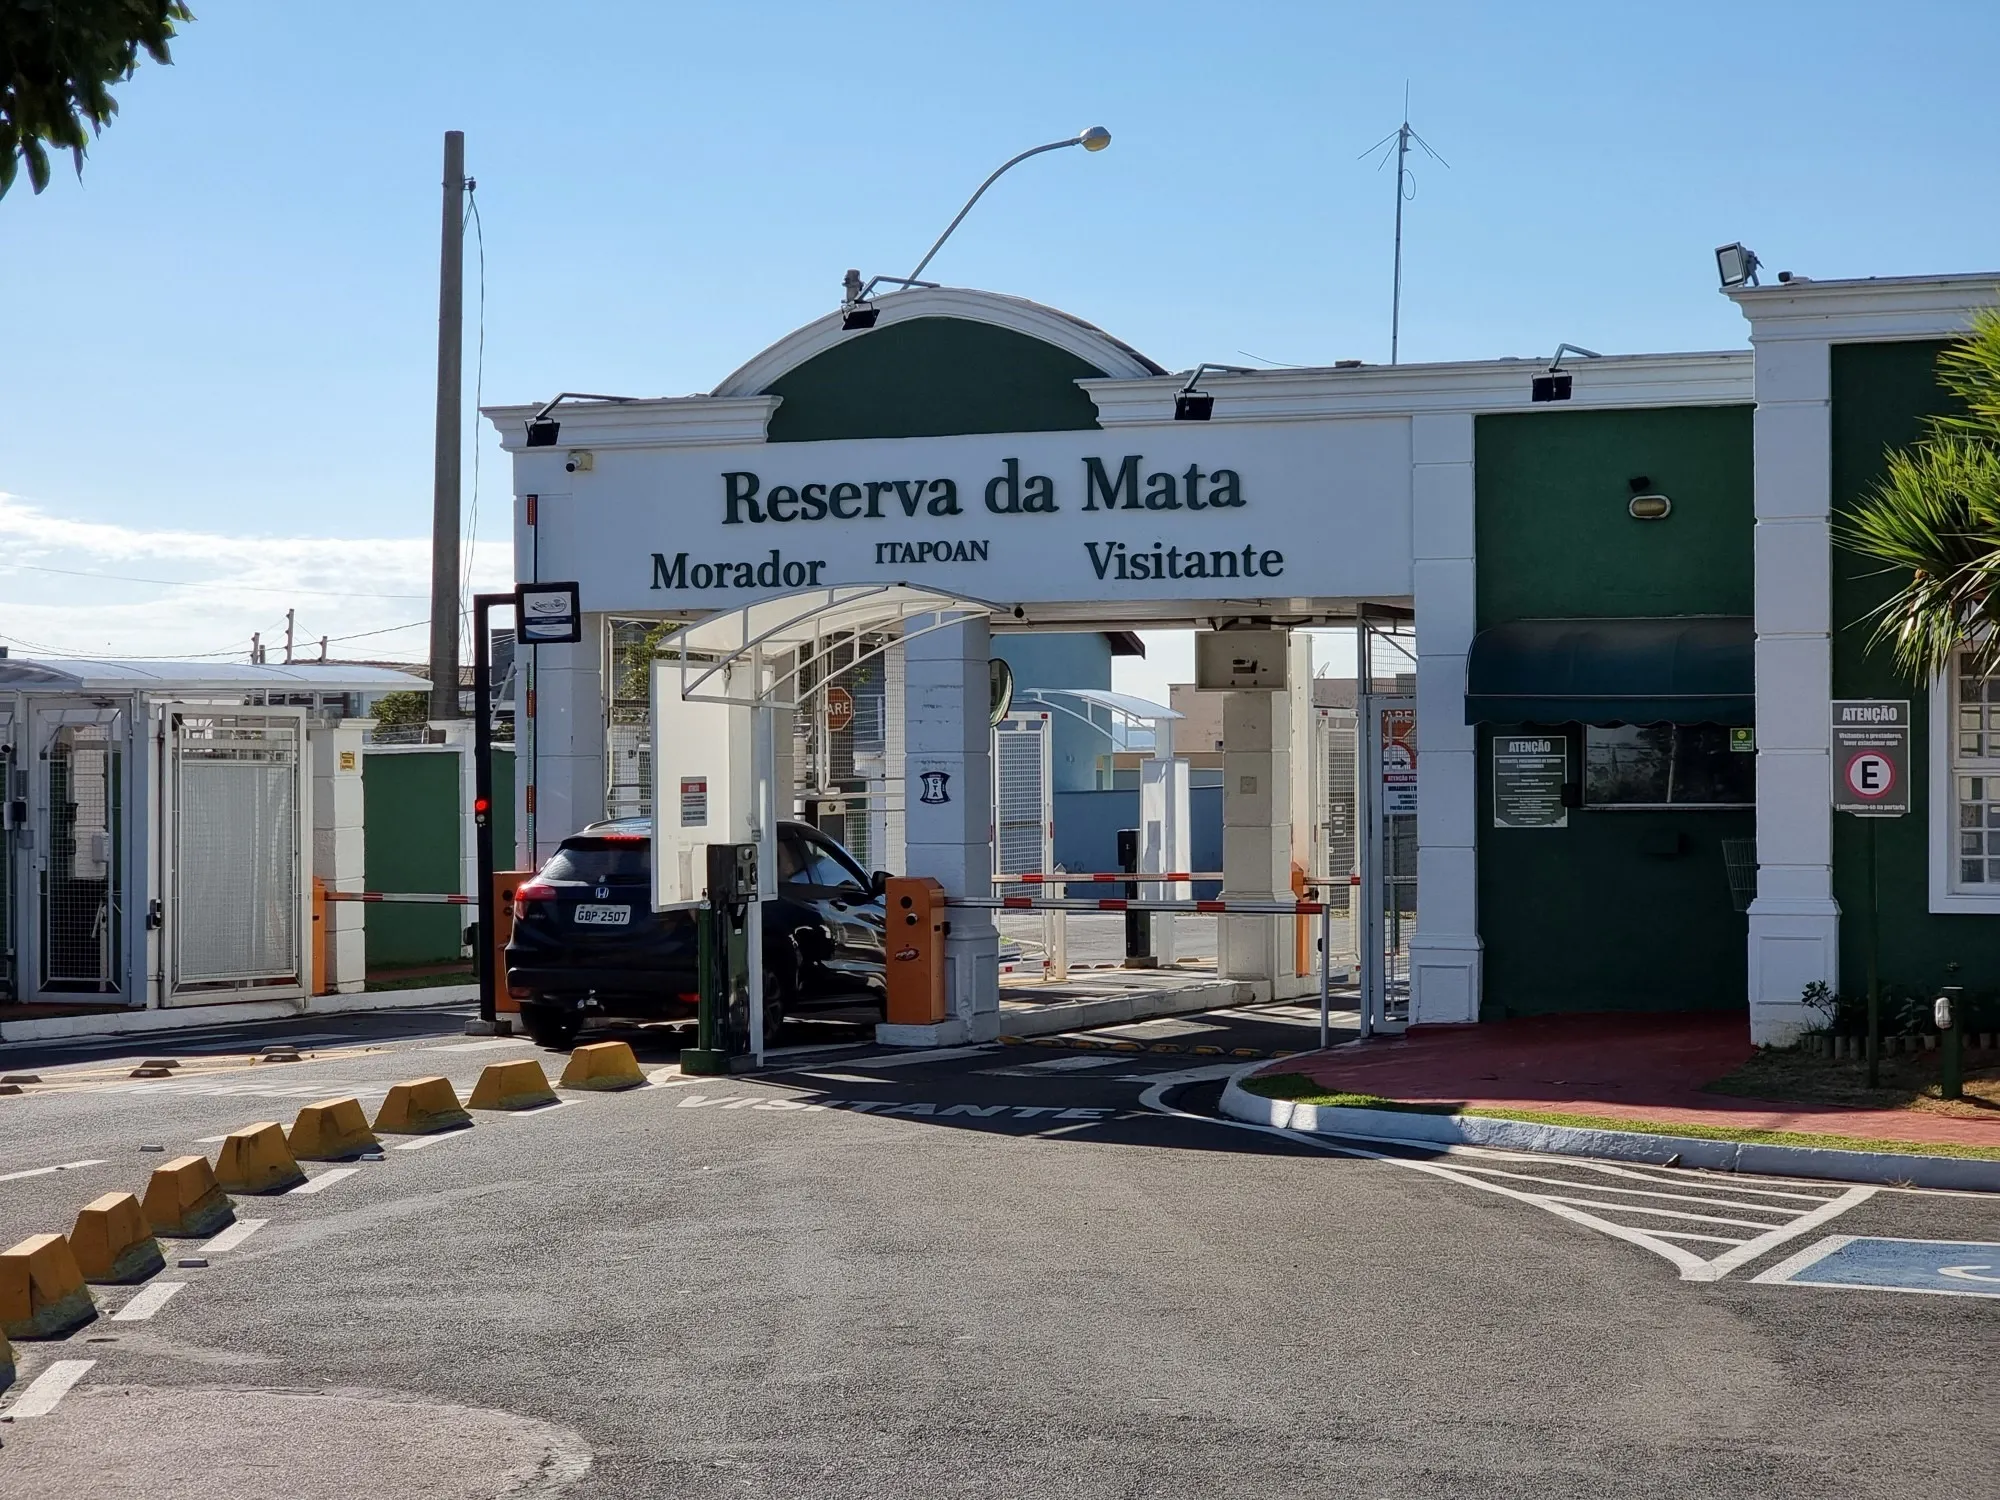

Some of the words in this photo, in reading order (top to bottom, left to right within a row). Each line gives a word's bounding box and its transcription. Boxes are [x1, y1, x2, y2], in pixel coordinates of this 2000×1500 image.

[721, 470, 963, 525] Reserva
[984, 458, 1059, 514] da
[1081, 455, 1246, 512] Mata
[875, 540, 990, 565] ITAPOAN
[1084, 541, 1285, 581] Visitante
[650, 550, 827, 590] Morador
[827, 702, 850, 716] ARE
[1383, 710, 1412, 724] ARE
[1842, 705, 1898, 723] ATENÇÃO
[1508, 739, 1551, 754] ATENÇÃO
[1861, 761, 1879, 789] E
[676, 1095, 1117, 1120] VISITANTE
